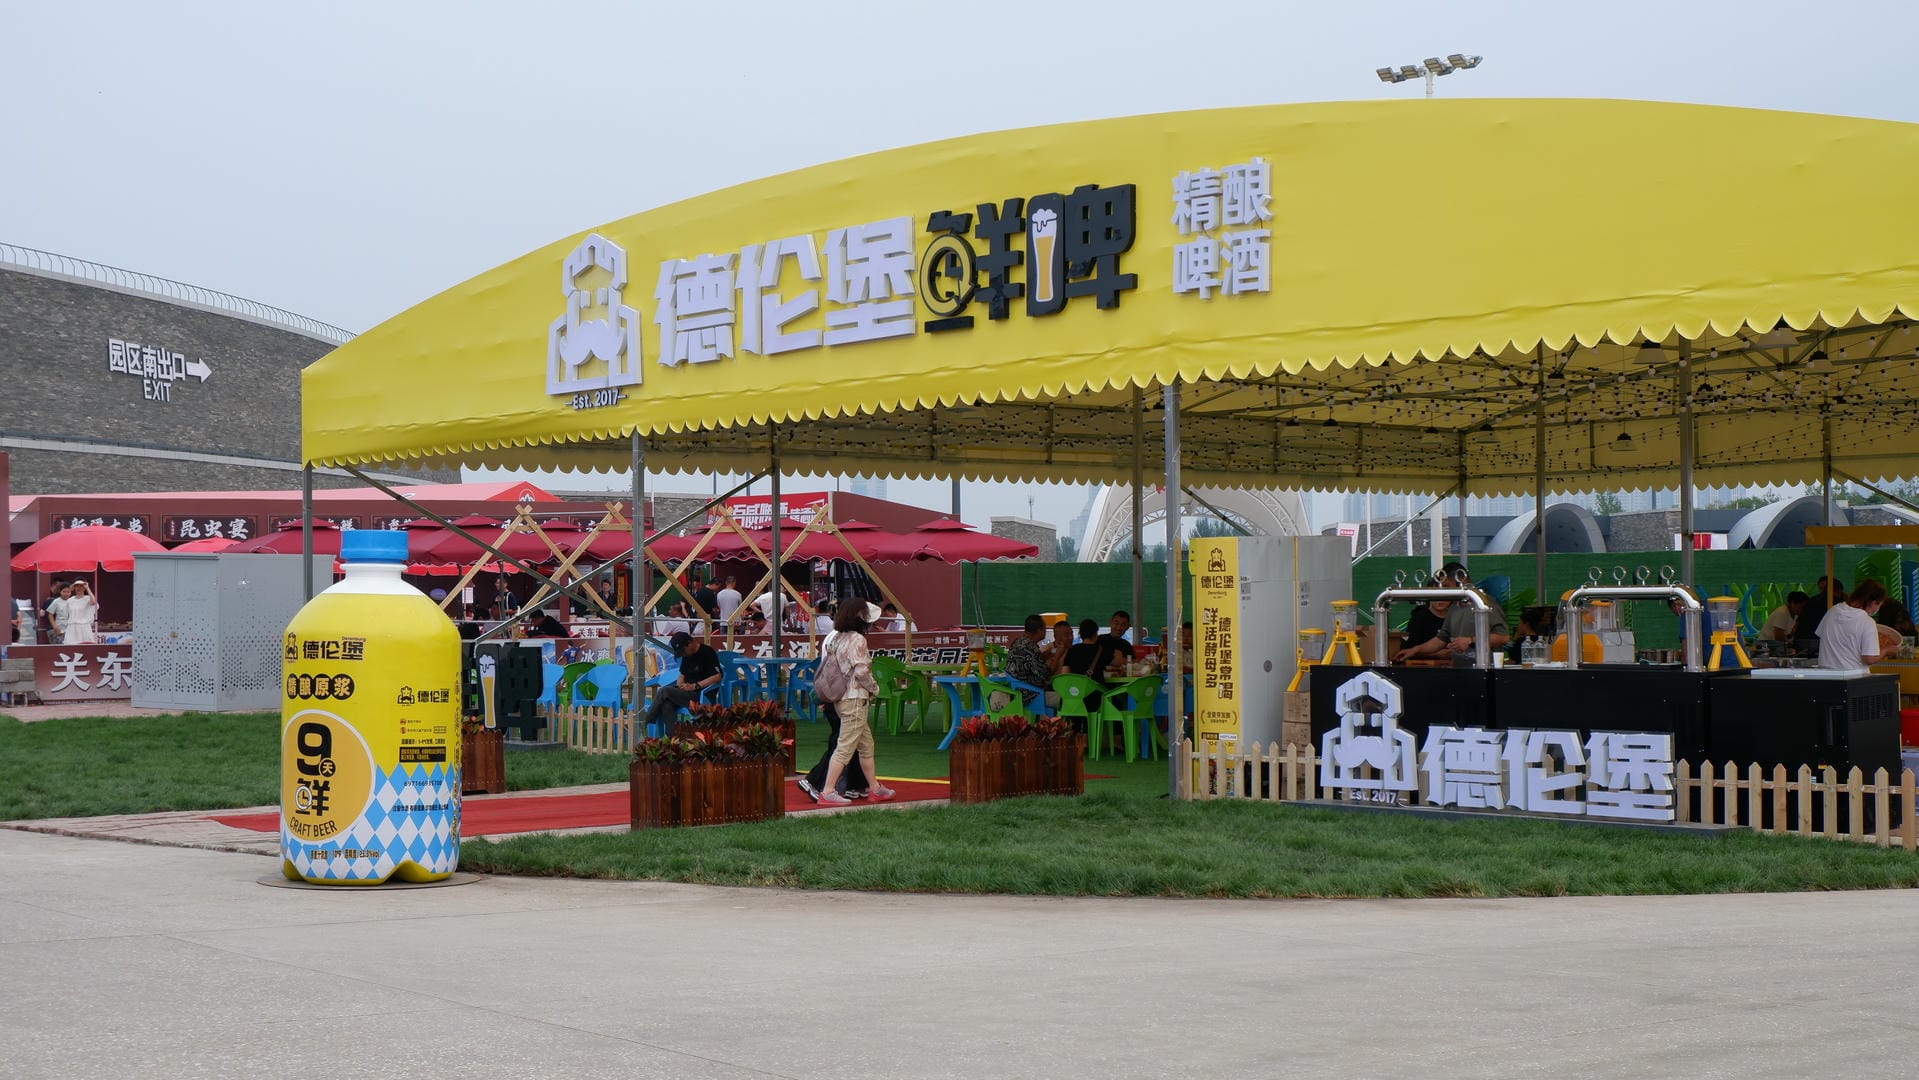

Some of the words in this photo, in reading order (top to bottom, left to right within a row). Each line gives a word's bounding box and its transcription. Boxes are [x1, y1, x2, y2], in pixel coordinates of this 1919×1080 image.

[1171, 157, 1273, 236] 精酿
[1172, 229, 1272, 300] 啤酒
[653, 214, 917, 367] 德伦堡
[920, 184, 1138, 333] 鲜啤
[107, 338, 186, 381] 园区南出口
[144, 379, 171, 402] EXIT
[572, 394, 593, 409] Est.
[593, 389, 619, 407] 2017
[180, 518, 249, 539] 昆虫宴
[1201, 575, 1234, 588] 德伦堡
[303, 640, 364, 660] 德伦堡
[288, 677, 351, 697] 精酿原浆
[418, 690, 449, 703] 德伦堡
[1421, 724, 1674, 821] 德伦堡
[1371, 790, 1397, 804] 2017
[289, 816, 312, 837] CRAFT
[313, 820, 338, 838] BEER
